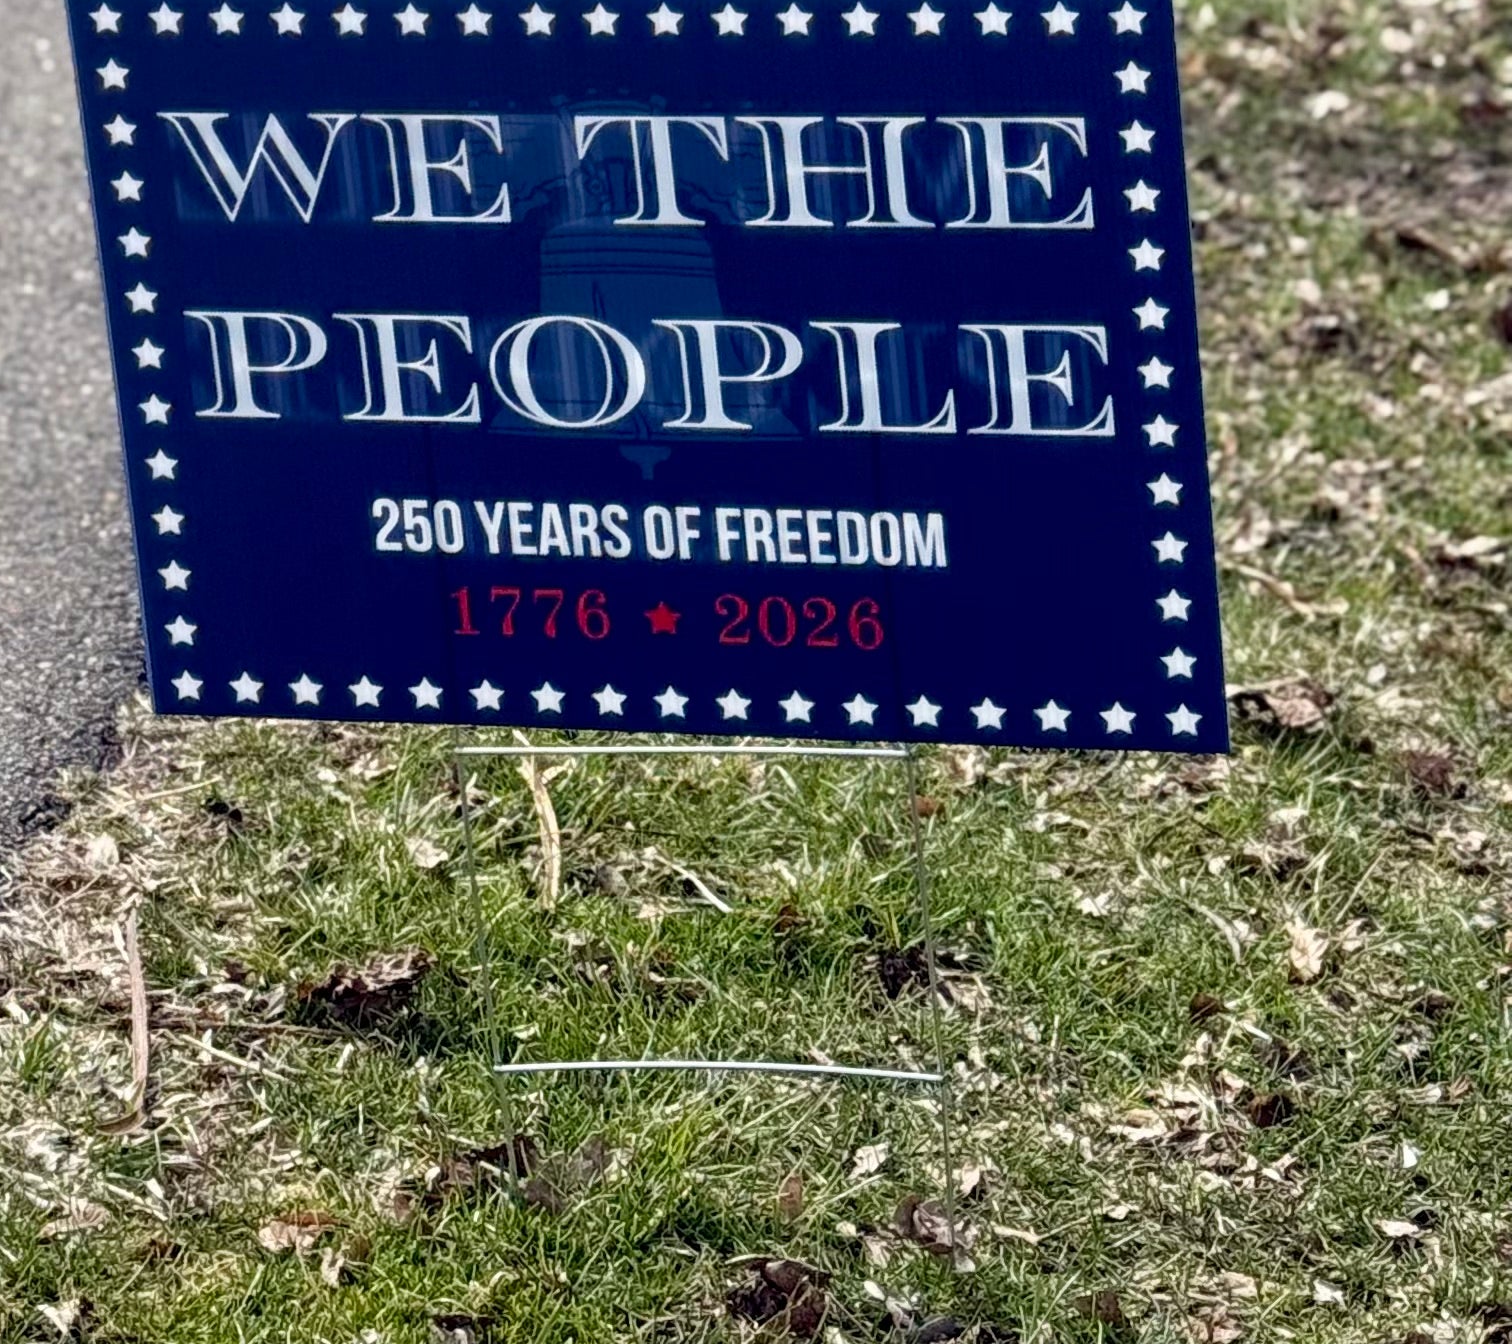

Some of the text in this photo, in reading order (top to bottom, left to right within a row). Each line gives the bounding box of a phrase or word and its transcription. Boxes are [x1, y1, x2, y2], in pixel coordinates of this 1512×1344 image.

[156, 111, 1095, 231] WE THE
[183, 309, 1117, 438] PEOPLE
[371, 497, 948, 569] 250 YEARS OF FREEDOM
[450, 585, 886, 651] 1776 2026
